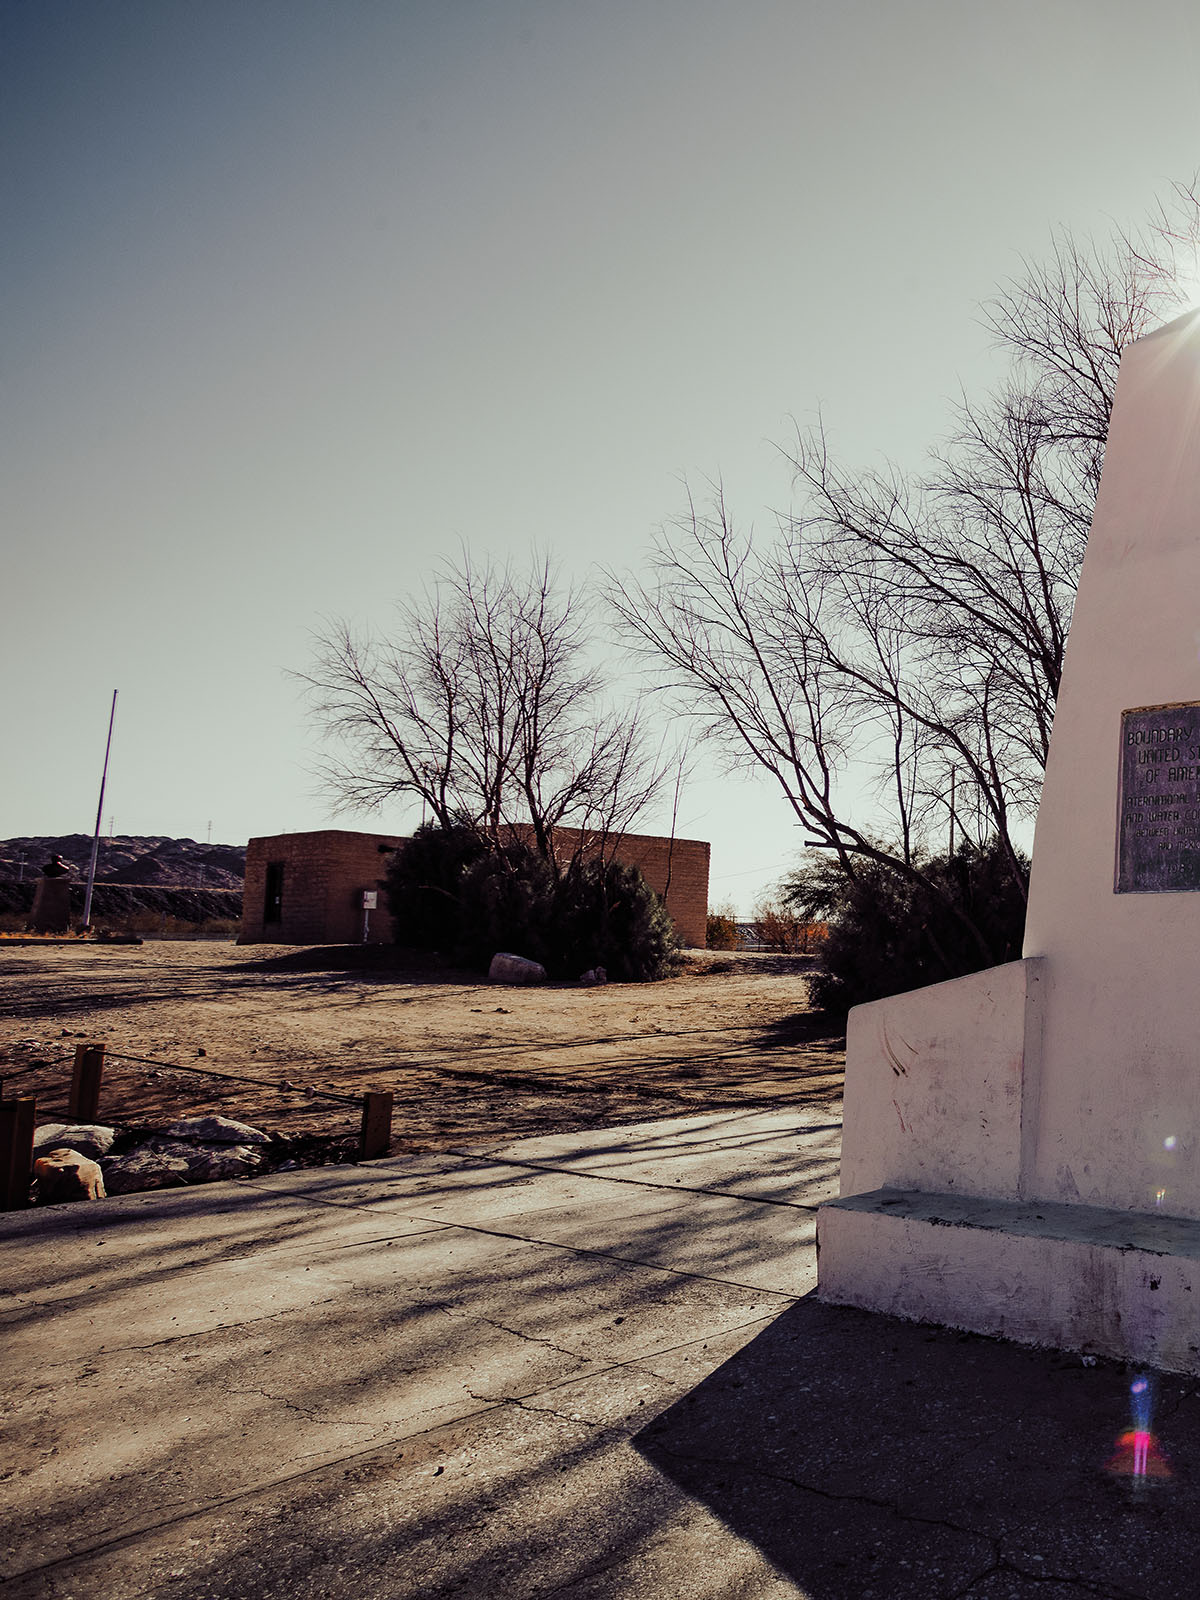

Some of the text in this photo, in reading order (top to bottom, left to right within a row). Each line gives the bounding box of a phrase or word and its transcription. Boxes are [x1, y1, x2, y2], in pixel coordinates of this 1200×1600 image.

[1127, 727, 1193, 746] BOUNDARY
[1138, 747, 1180, 765] UNITED
[1145, 768, 1160, 784] OF
[1124, 793, 1190, 809] INTERNATIONAL
[1126, 812, 1144, 823] AND
[1148, 810, 1180, 823] WATER
